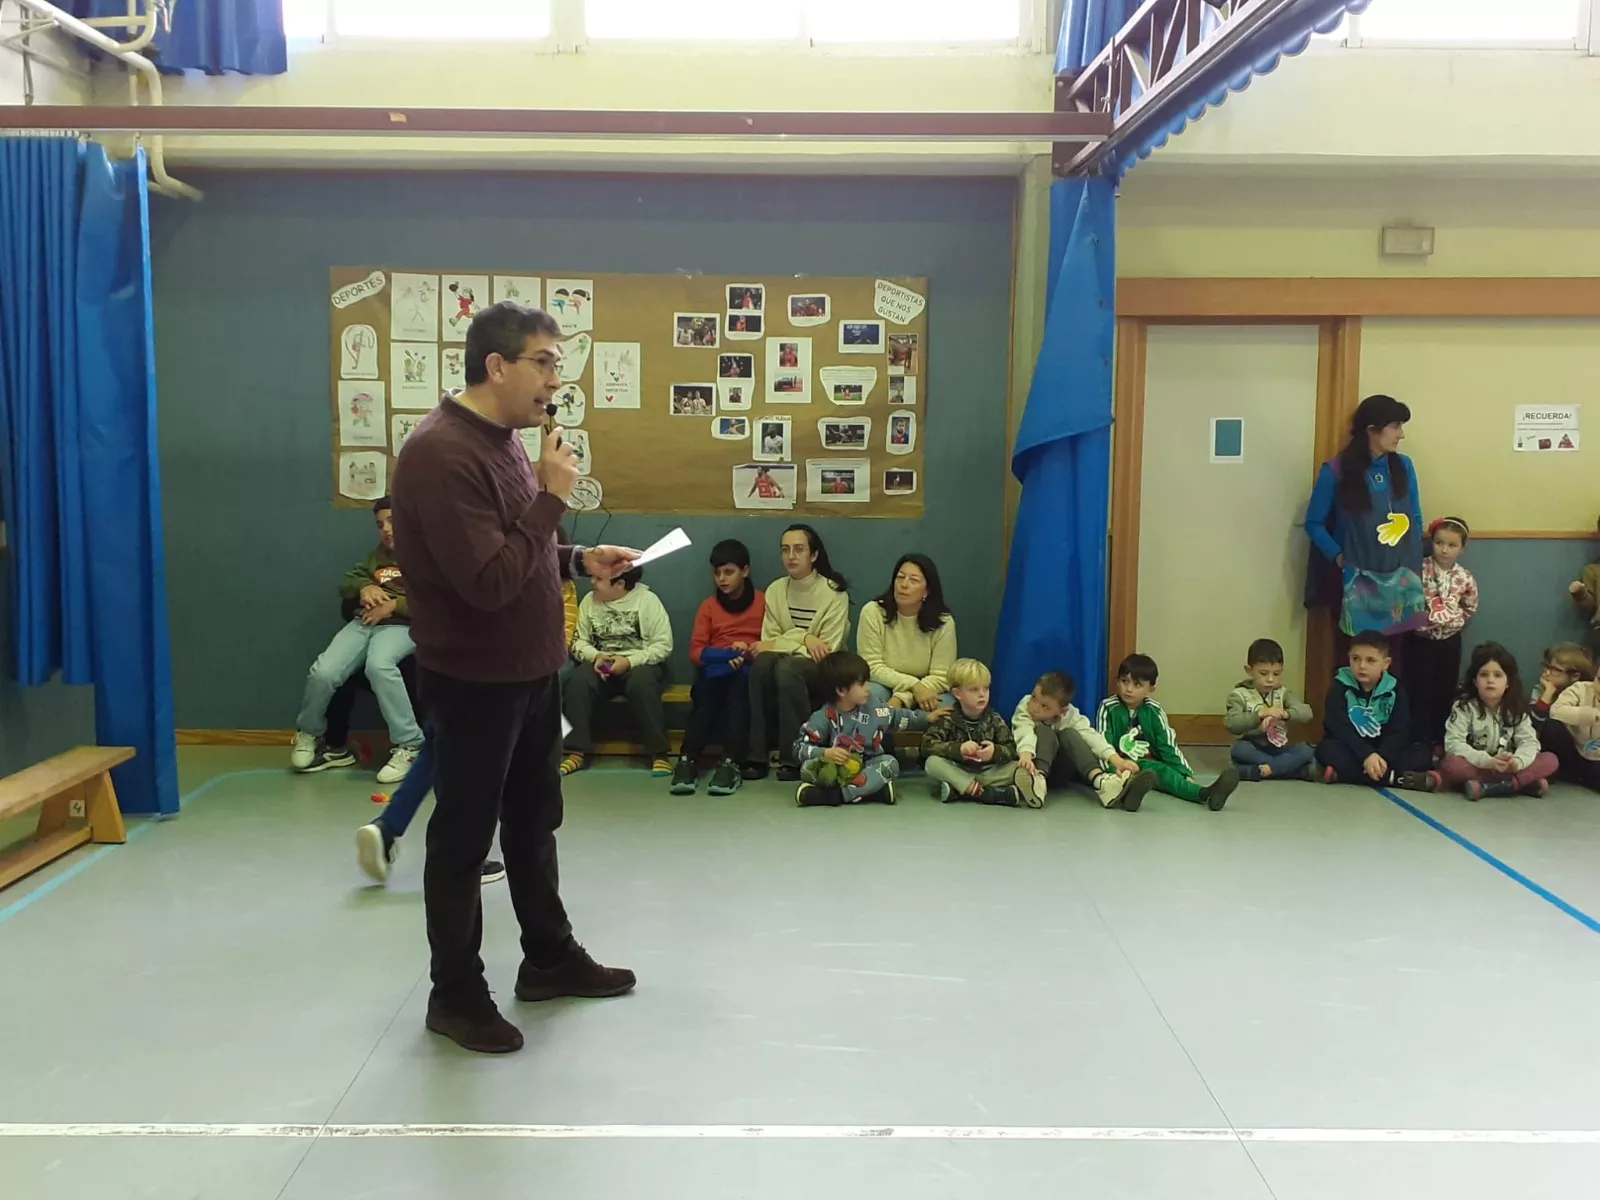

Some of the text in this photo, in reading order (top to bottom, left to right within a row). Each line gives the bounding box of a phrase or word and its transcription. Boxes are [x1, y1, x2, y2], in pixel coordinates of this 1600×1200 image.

[332, 276, 383, 305] DEPORTES
[877, 282, 924, 306] DEPORTISTAS
[880, 295, 911, 313] QUE NOS
[877, 306, 906, 323] GUSTAN
[1523, 412, 1572, 421] ¡RECUERDA!
[380, 569, 402, 577] JAC
